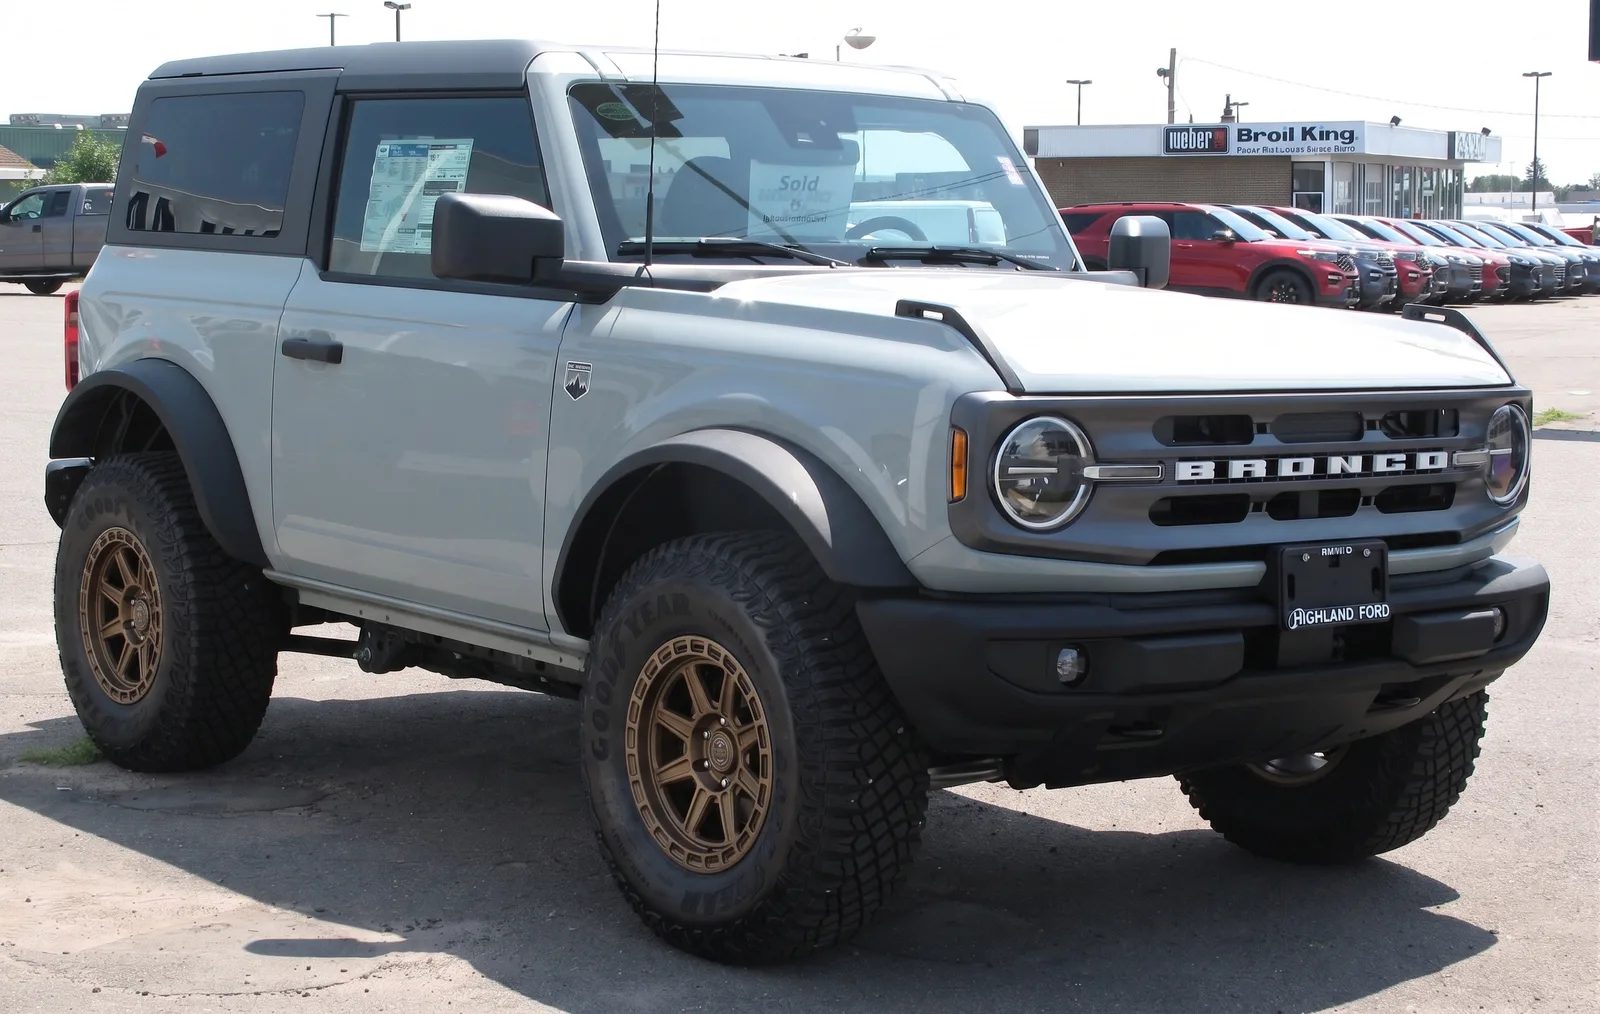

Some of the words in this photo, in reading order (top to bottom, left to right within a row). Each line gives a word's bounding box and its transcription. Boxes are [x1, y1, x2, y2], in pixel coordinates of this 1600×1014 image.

[1169, 128, 1213, 150] weber
[1237, 126, 1295, 143] Broil
[1301, 125, 1355, 145] King
[779, 175, 820, 192] Sold
[1175, 451, 1448, 481] BRONCO
[1288, 607, 1354, 629] HIGHLAND
[1359, 604, 1390, 619] FORD
